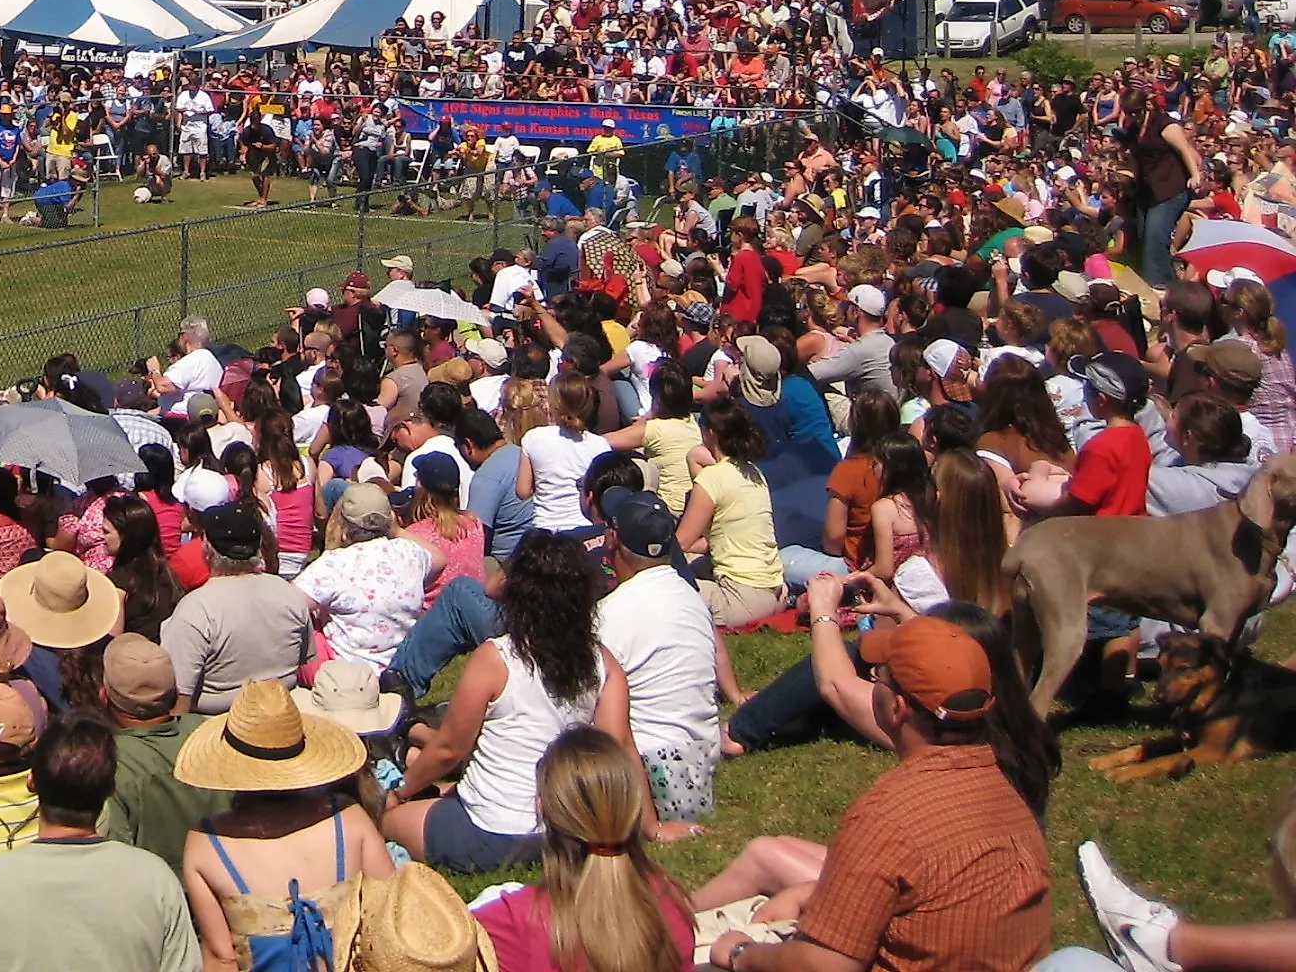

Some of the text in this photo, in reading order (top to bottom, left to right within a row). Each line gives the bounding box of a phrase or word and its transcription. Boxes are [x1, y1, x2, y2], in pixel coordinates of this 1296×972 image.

[61, 54, 89, 62] MEDCAL
[470, 102, 501, 117] Signs
[504, 104, 525, 116] and
[529, 105, 581, 120] Graphics
[628, 108, 661, 121] Texas
[529, 122, 571, 135] Kansas
